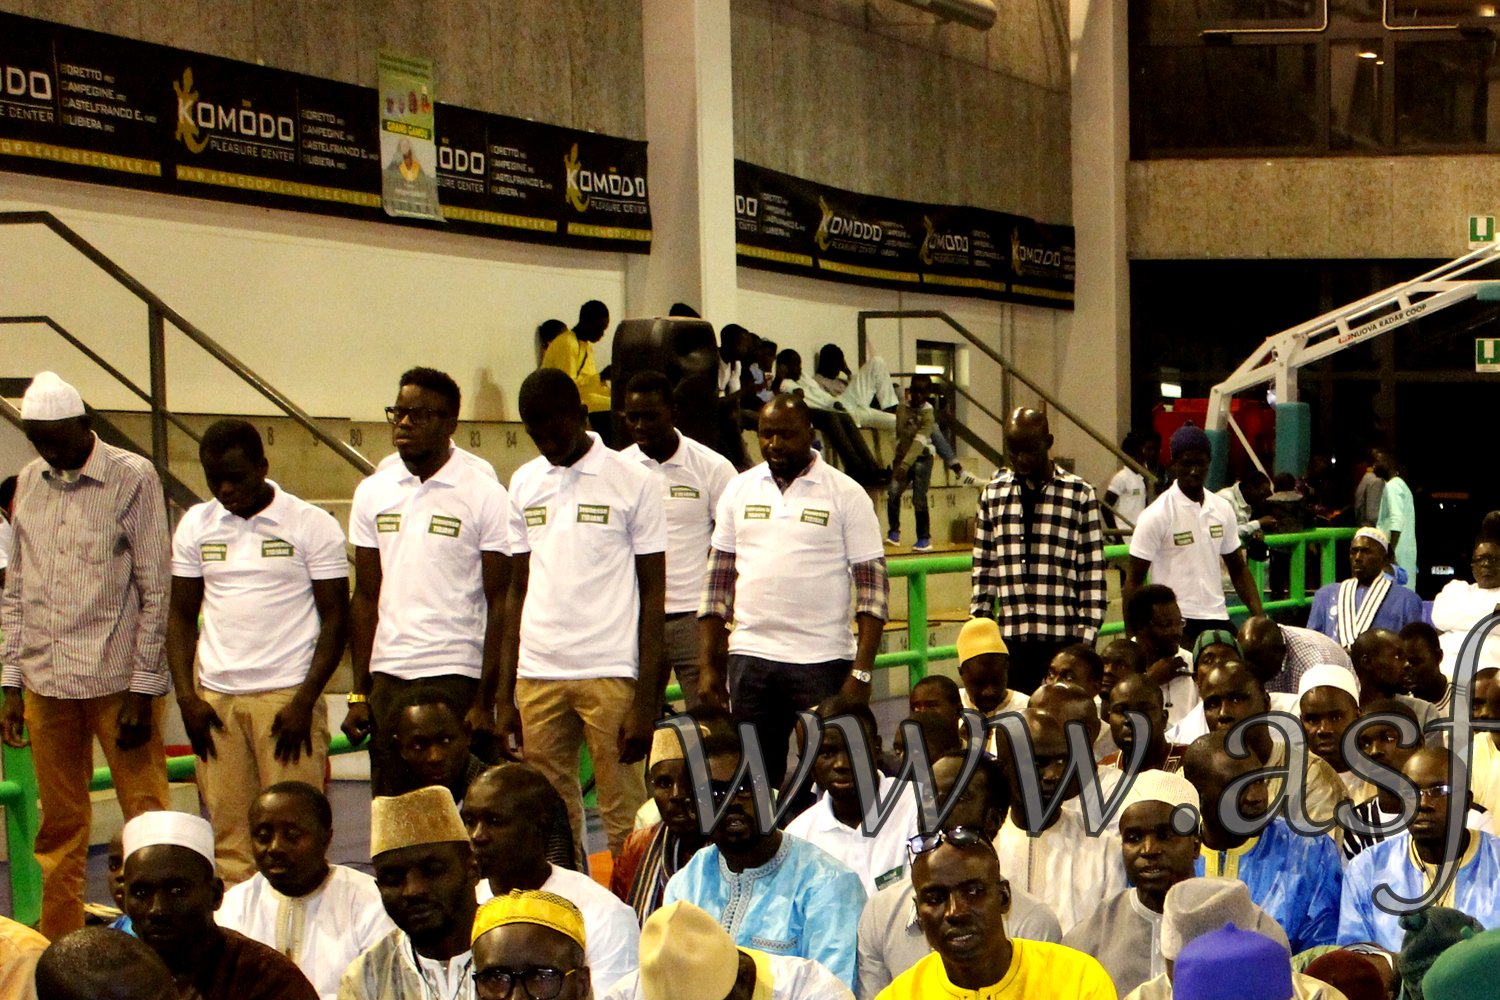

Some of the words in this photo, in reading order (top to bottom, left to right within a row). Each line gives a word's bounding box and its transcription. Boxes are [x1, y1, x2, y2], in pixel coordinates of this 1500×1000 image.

[0, 65, 52, 101] DO
[210, 140, 258, 157] PLEASURE
[261, 148, 295, 162] CENTER
[1350, 324, 1377, 339] NUOVA
[1379, 313, 1404, 328] RADAR
[1405, 303, 1428, 317] COOP
[470, 430, 481, 447] 83
[506, 431, 517, 448] 84
